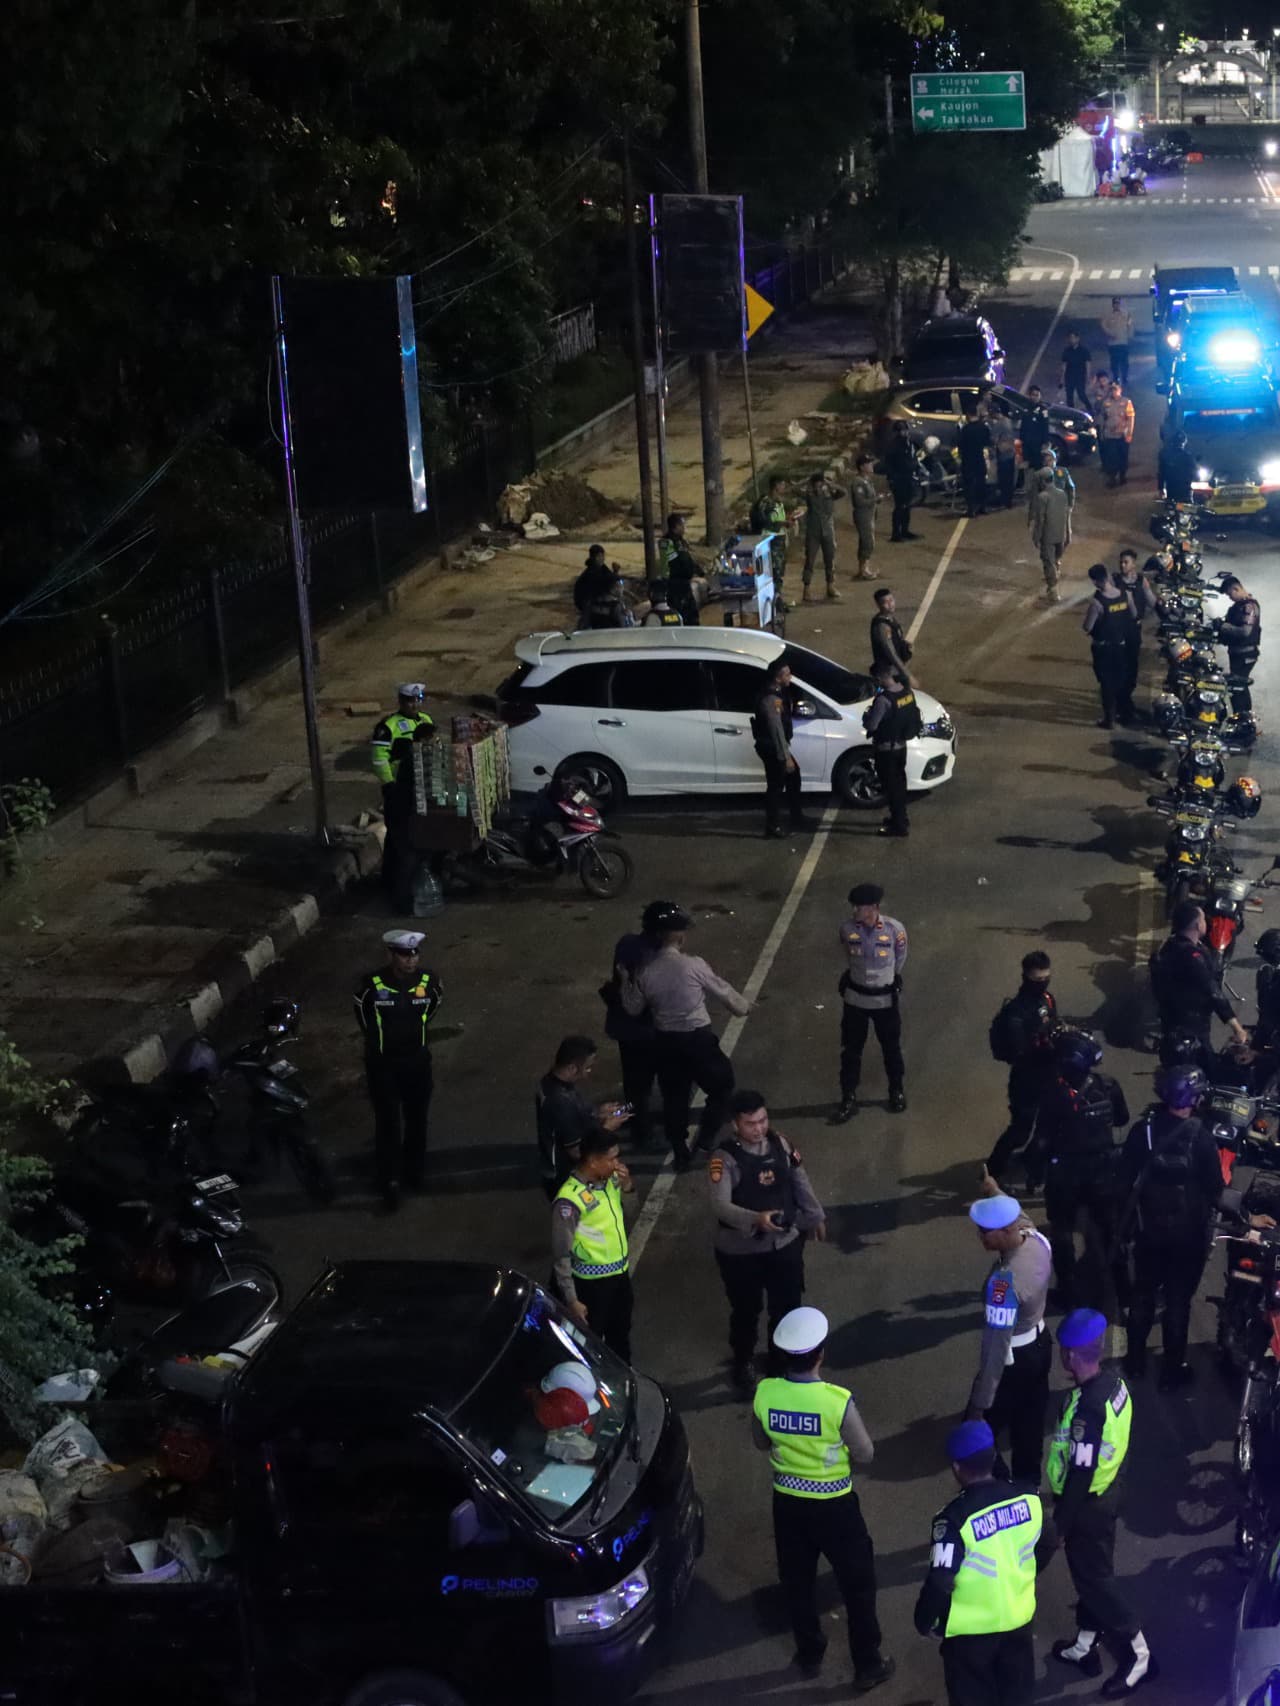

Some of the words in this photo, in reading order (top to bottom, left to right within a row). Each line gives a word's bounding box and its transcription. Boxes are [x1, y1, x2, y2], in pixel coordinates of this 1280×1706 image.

[941, 115, 994, 124] Taktakan
[769, 1412, 819, 1433] POLISI
[462, 1576, 539, 1592] PELINDO
